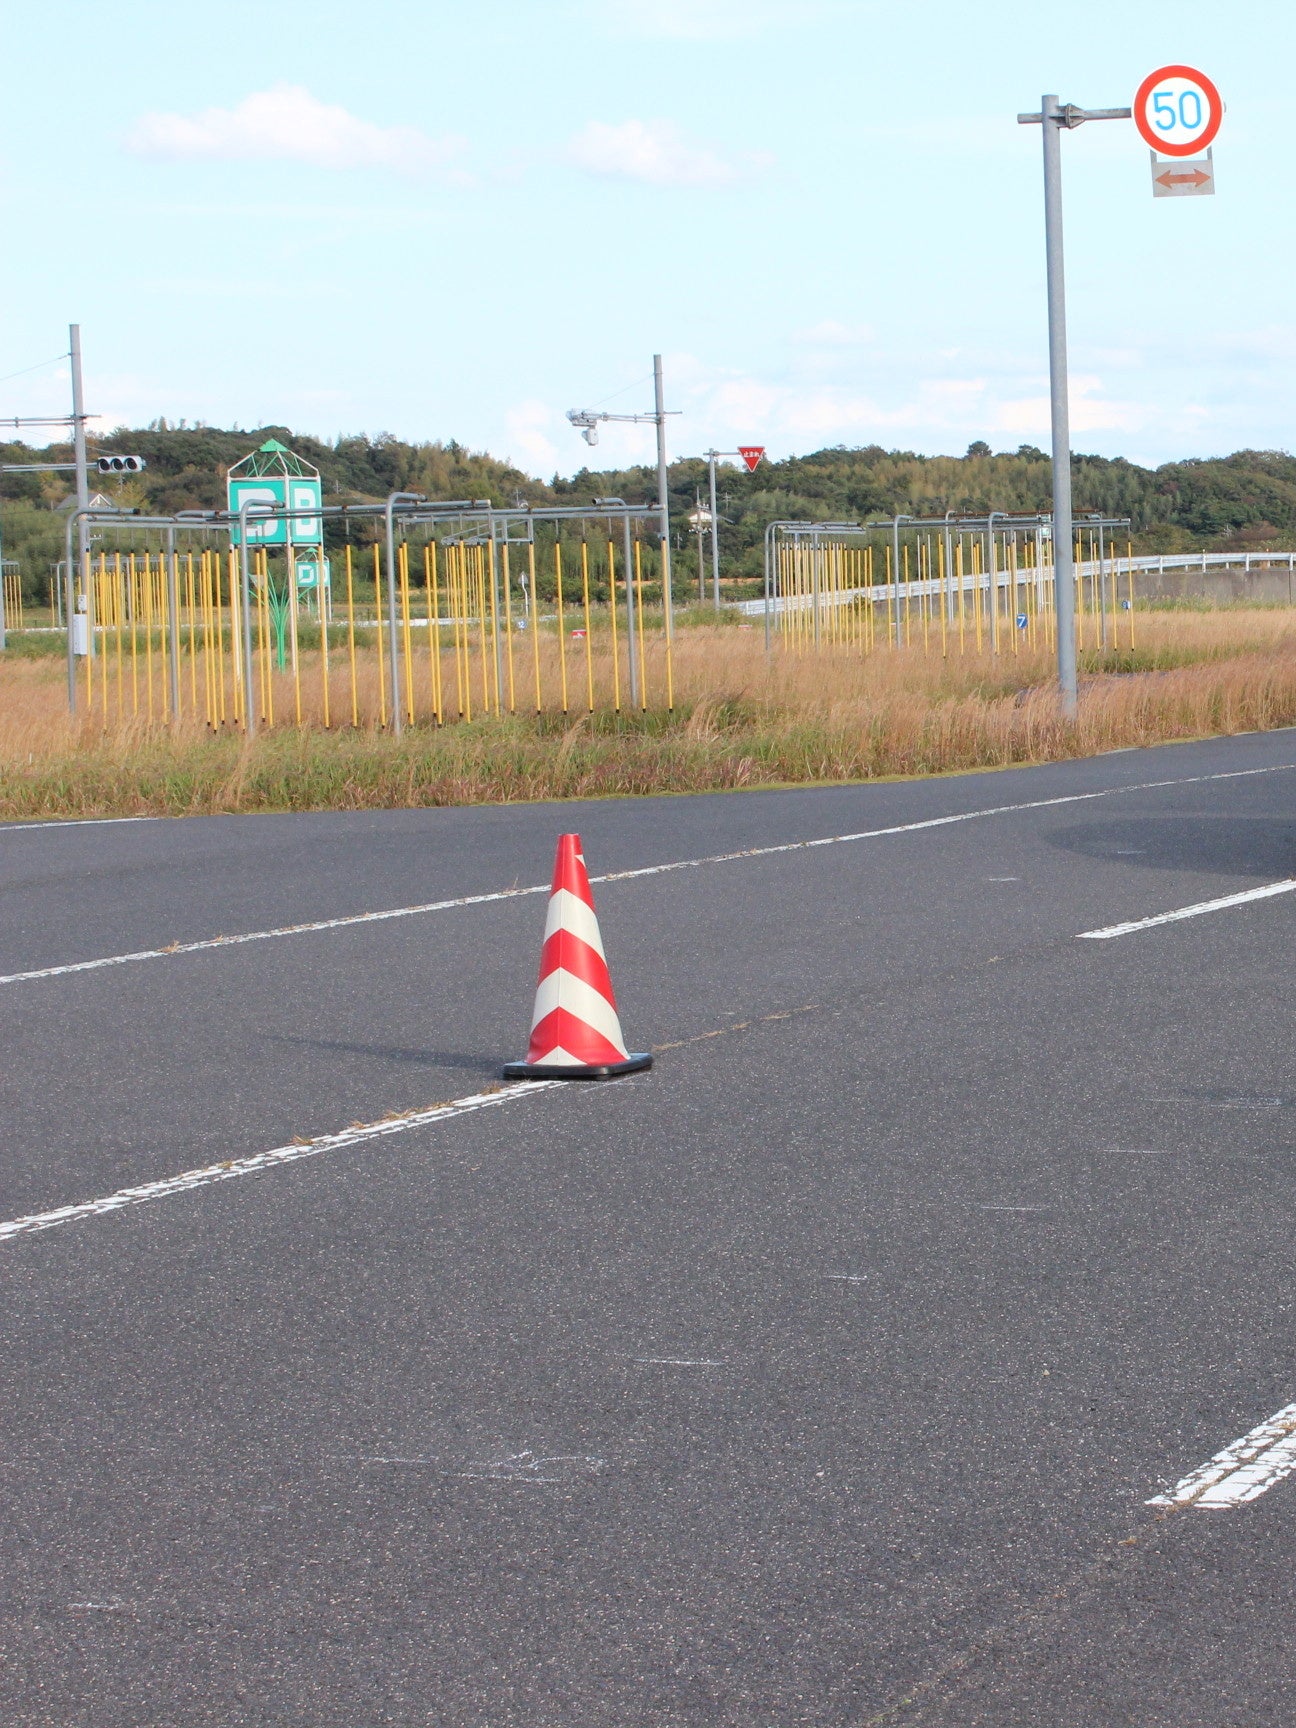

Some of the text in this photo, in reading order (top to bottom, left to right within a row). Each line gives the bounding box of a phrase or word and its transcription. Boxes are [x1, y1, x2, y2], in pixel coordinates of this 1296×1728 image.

[1153, 90, 1202, 131] 50
[294, 488, 316, 536] B
[298, 565, 315, 583] D
[1017, 616, 1026, 627] 7
